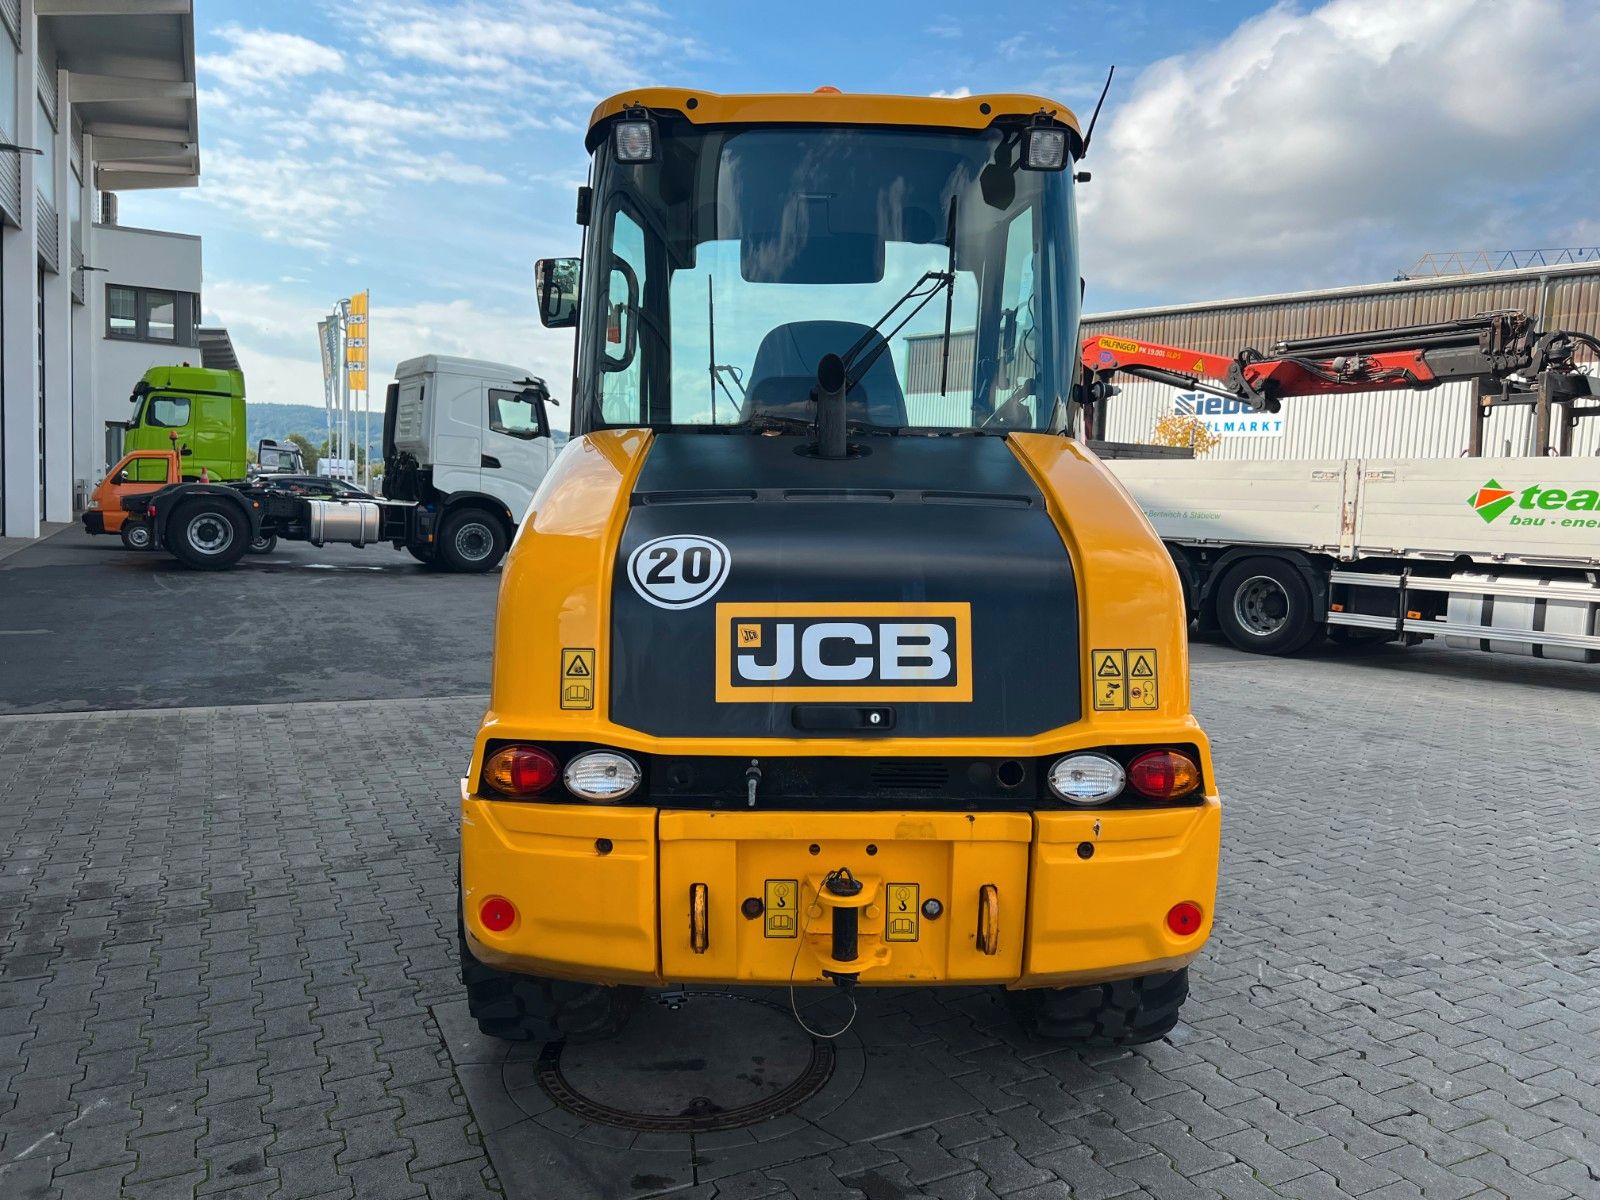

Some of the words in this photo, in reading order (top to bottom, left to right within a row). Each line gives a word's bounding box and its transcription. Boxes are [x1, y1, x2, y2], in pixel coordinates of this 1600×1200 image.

[1100, 339, 1137, 352] PALFINGER
[1138, 346, 1147, 354] PK
[1147, 348, 1166, 358] 19.001
[1519, 484, 1600, 511] tea
[1182, 511, 1188, 519] &
[1510, 515, 1545, 526] bau
[1561, 519, 1600, 528] ene
[646, 547, 712, 585] 20
[744, 630, 759, 642] JCB
[737, 622, 951, 681] JCB
